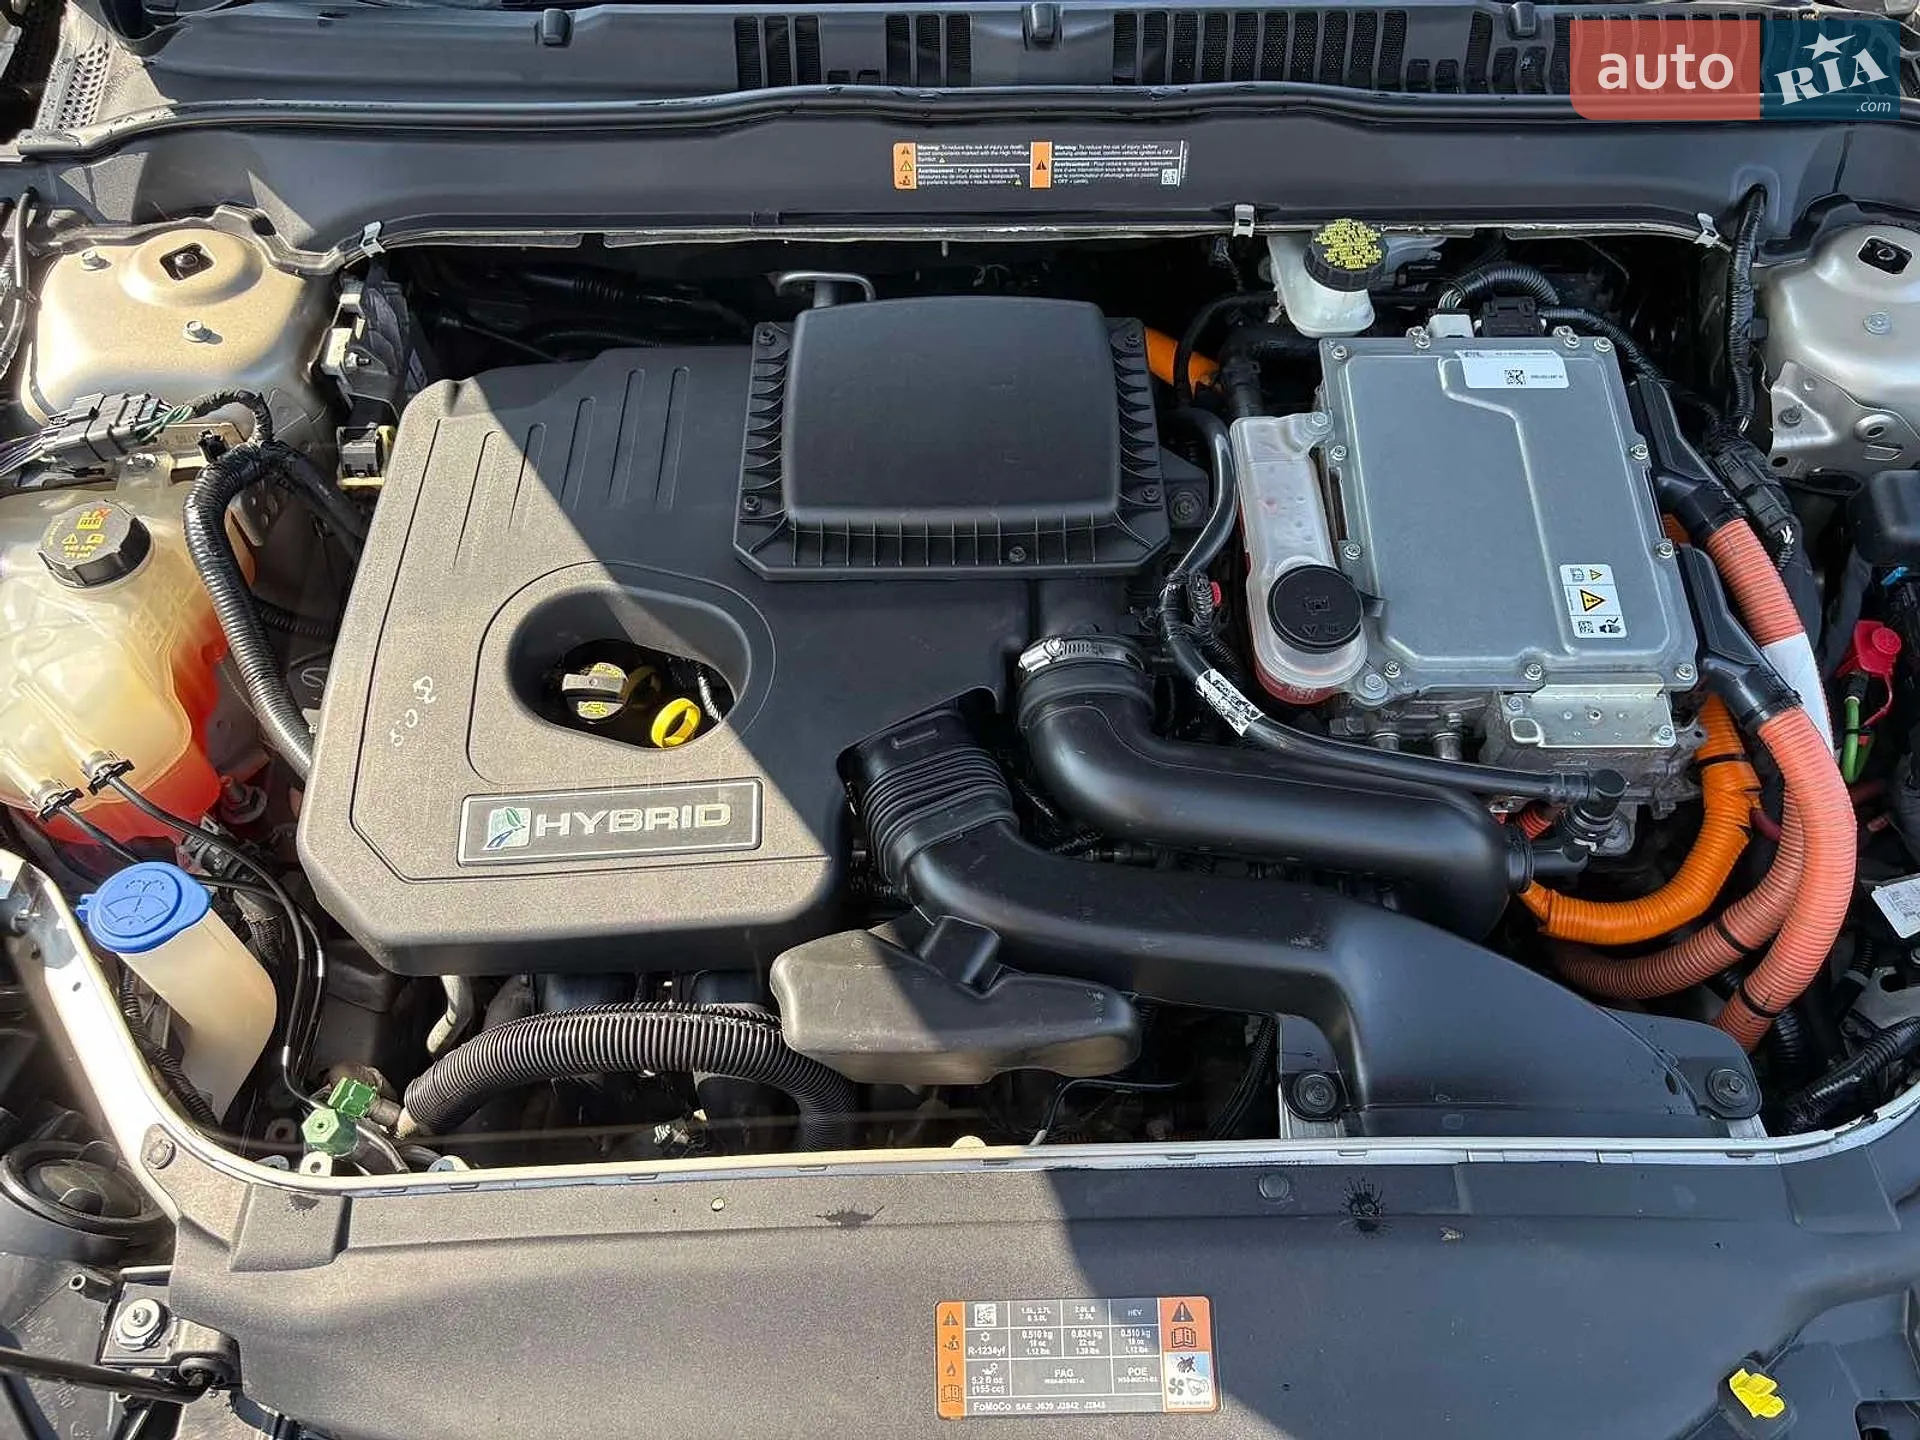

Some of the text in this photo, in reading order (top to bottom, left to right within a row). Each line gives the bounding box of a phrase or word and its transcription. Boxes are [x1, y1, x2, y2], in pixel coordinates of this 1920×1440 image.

[535, 803, 732, 837] HYBRID
[1128, 1309, 1143, 1317] HEV
[968, 1346, 1006, 1356] R-1234yf
[1054, 1368, 1074, 1378] PAG
[1128, 1367, 1148, 1376] POE
[973, 1402, 1012, 1411] FoMoCo
